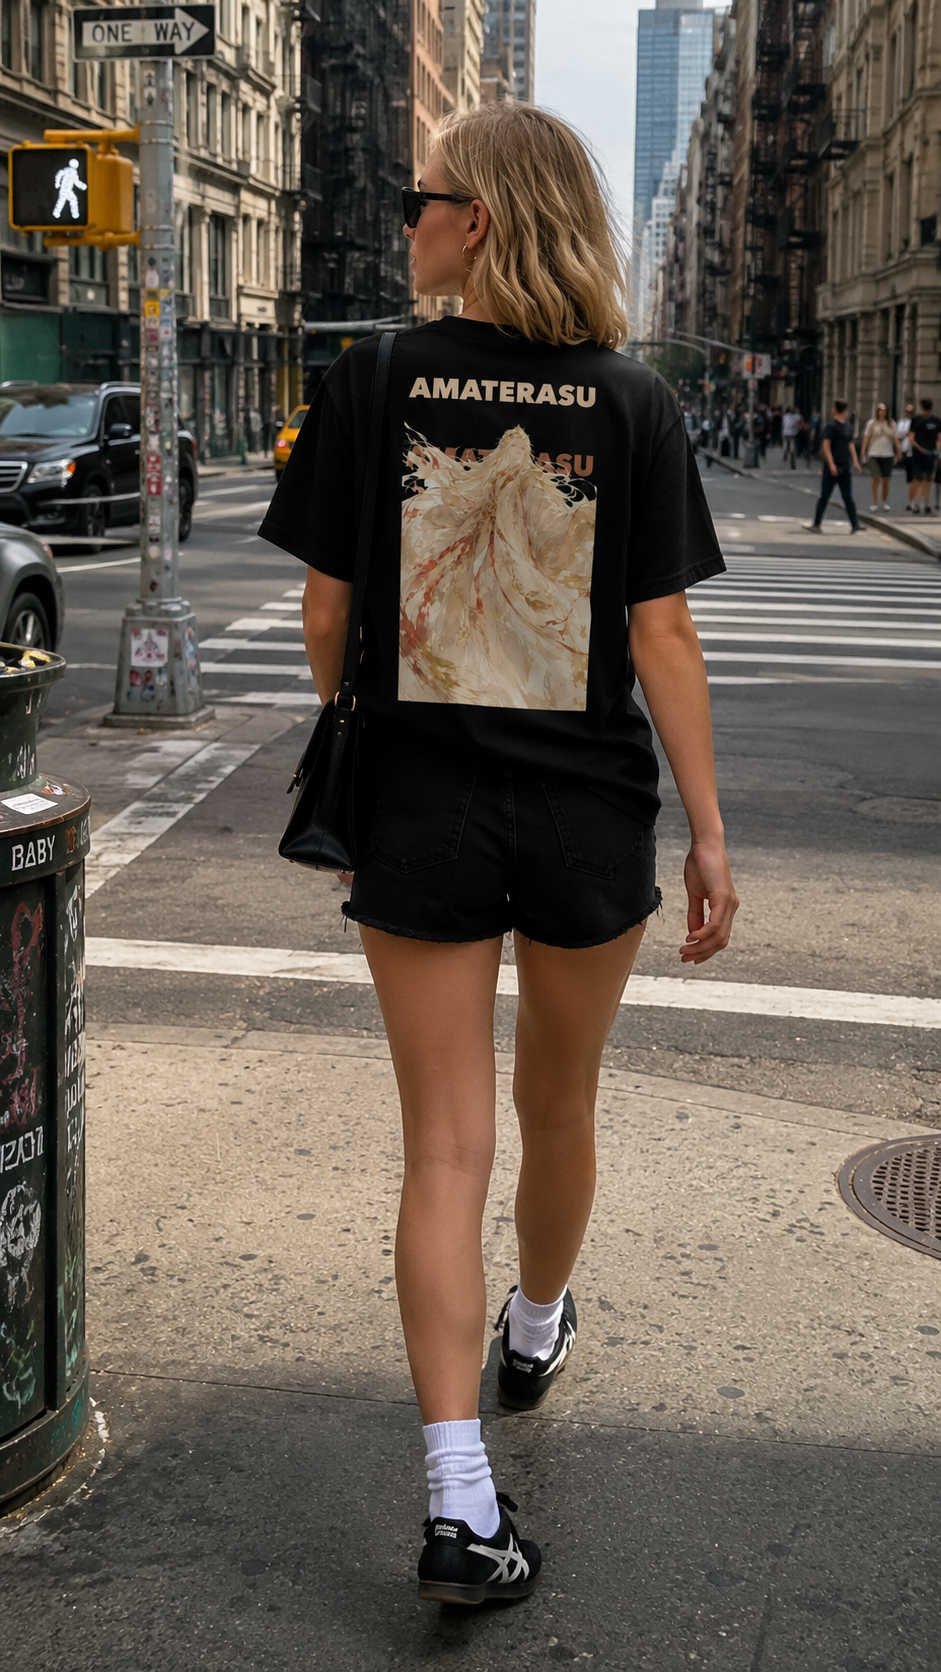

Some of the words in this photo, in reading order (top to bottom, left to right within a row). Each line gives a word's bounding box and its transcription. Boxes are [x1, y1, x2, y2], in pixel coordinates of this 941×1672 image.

[92, 23, 132, 43] ONE
[154, 22, 195, 41] WAY
[409, 377, 596, 408] AMATERASU
[11, 834, 56, 872] BABY
